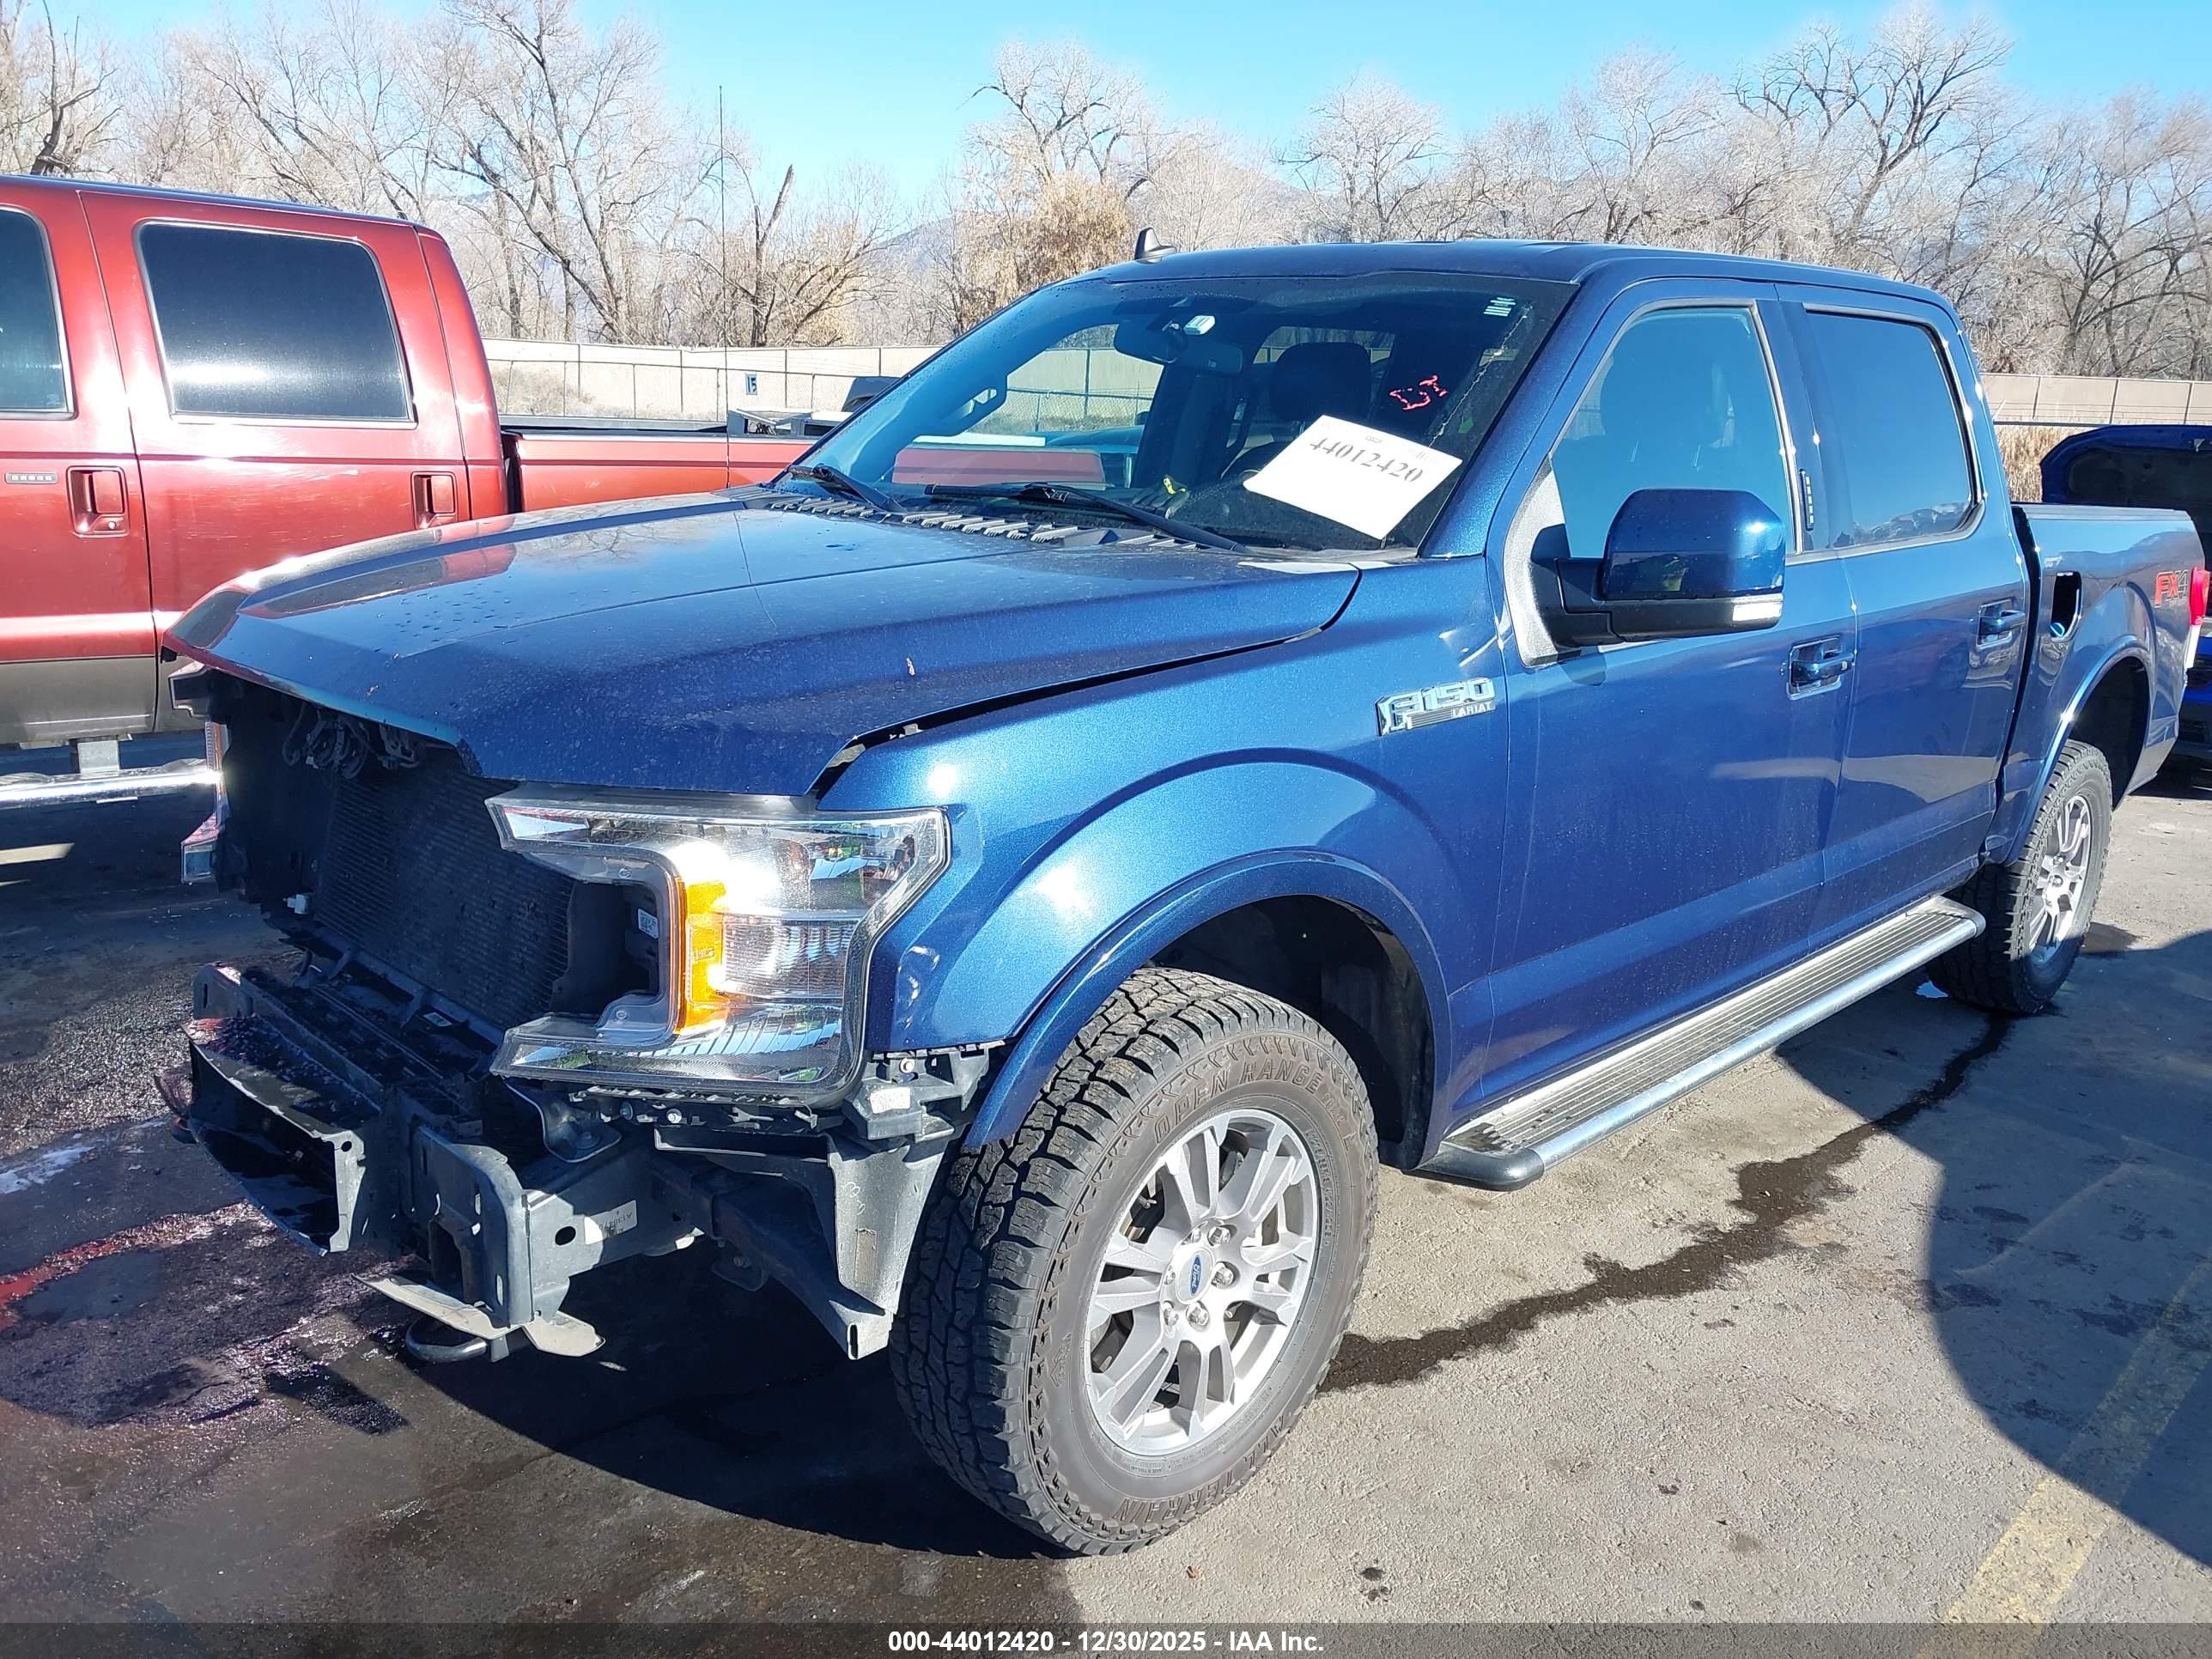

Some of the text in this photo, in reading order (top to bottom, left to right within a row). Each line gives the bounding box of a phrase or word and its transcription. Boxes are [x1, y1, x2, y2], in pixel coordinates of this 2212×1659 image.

[1309, 437, 1424, 483] 44012420
[2154, 569, 2190, 608] FX4
[1452, 702, 1492, 718] LARIAT
[1152, 1057, 1324, 1144] OPEN RANGE
[1113, 1469, 1240, 1522] TERRAIN
